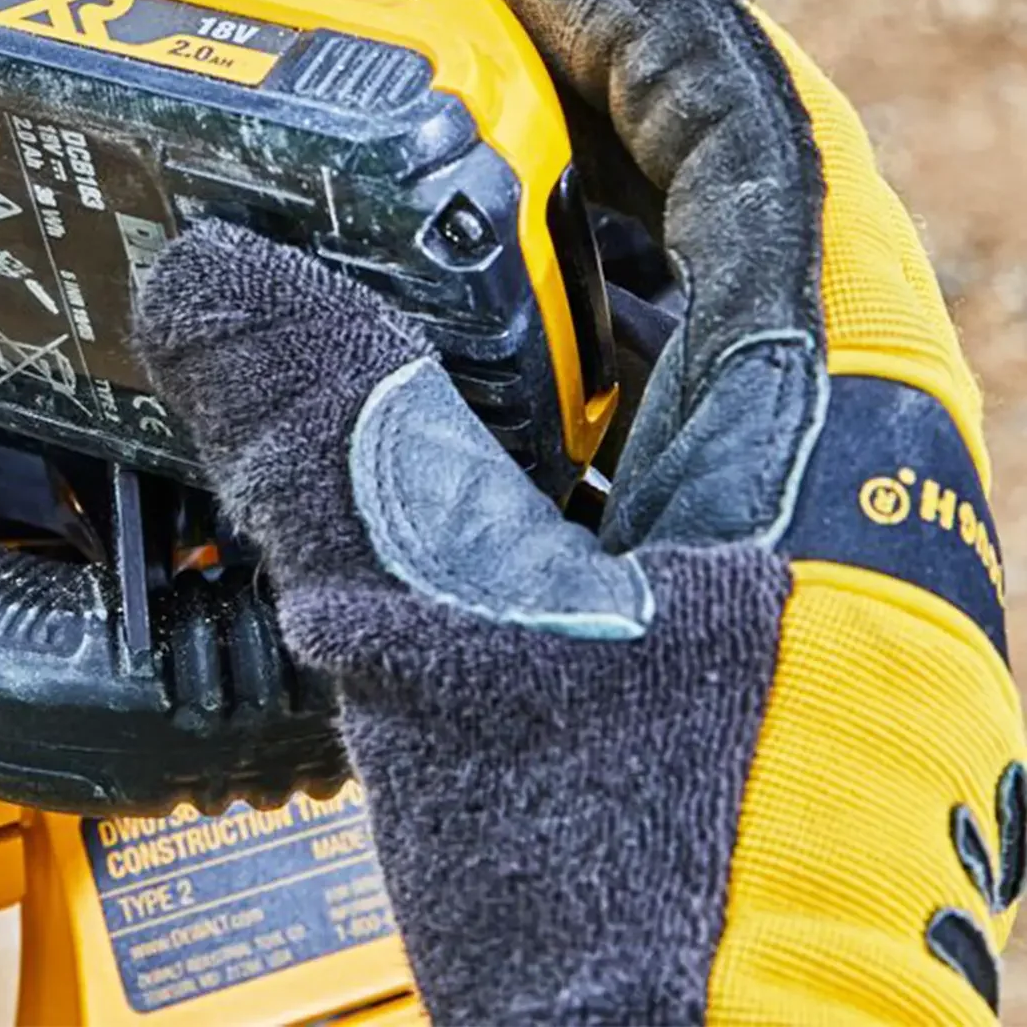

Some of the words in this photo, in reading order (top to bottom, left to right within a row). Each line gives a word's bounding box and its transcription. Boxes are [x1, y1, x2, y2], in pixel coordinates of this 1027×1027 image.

[196, 17, 261, 44] 18V
[107, 803, 293, 879] CONSTRUCTION
[117, 891, 174, 923] TYPE
[178, 880, 195, 906] 2
